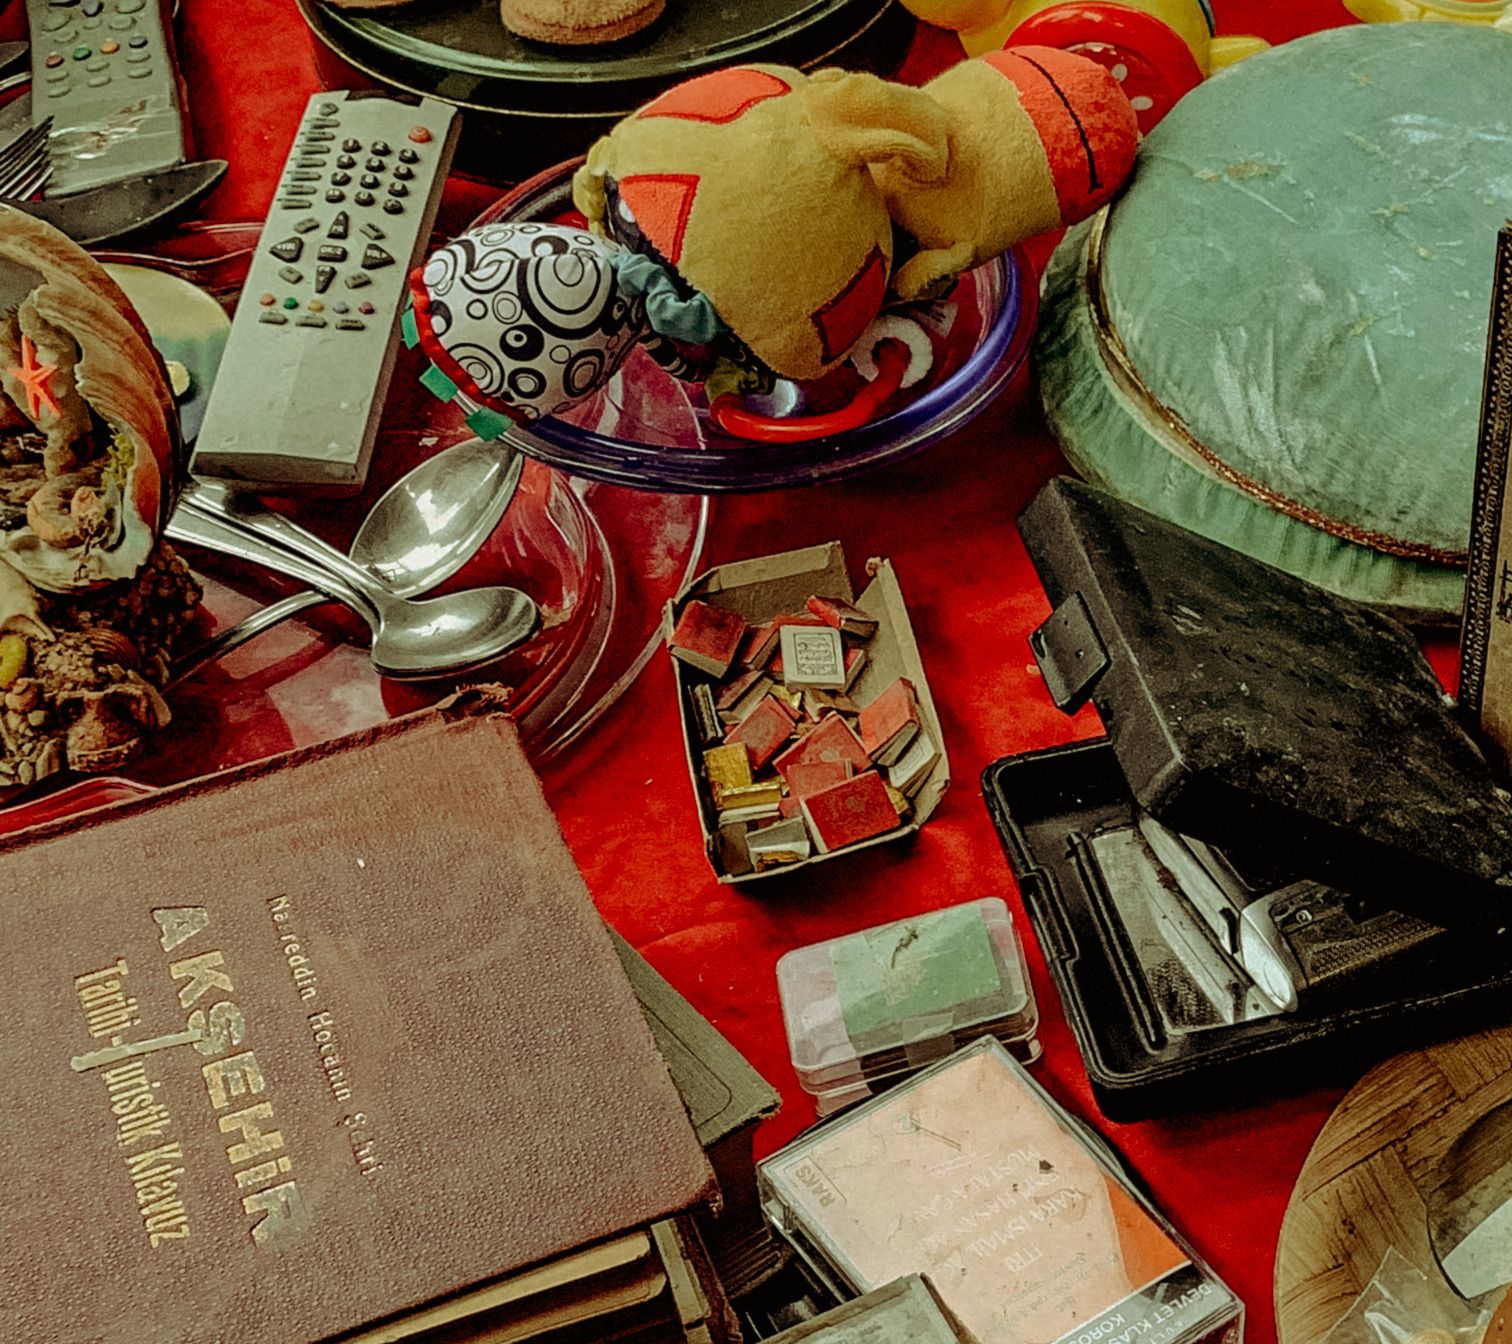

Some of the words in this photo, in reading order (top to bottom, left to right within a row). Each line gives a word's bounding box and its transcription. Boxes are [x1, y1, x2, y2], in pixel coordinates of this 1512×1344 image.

[792, 1158, 837, 1214] RAKS
[1028, 1183, 1083, 1225] KARA
[1150, 1278, 1213, 1326] DEVLET
